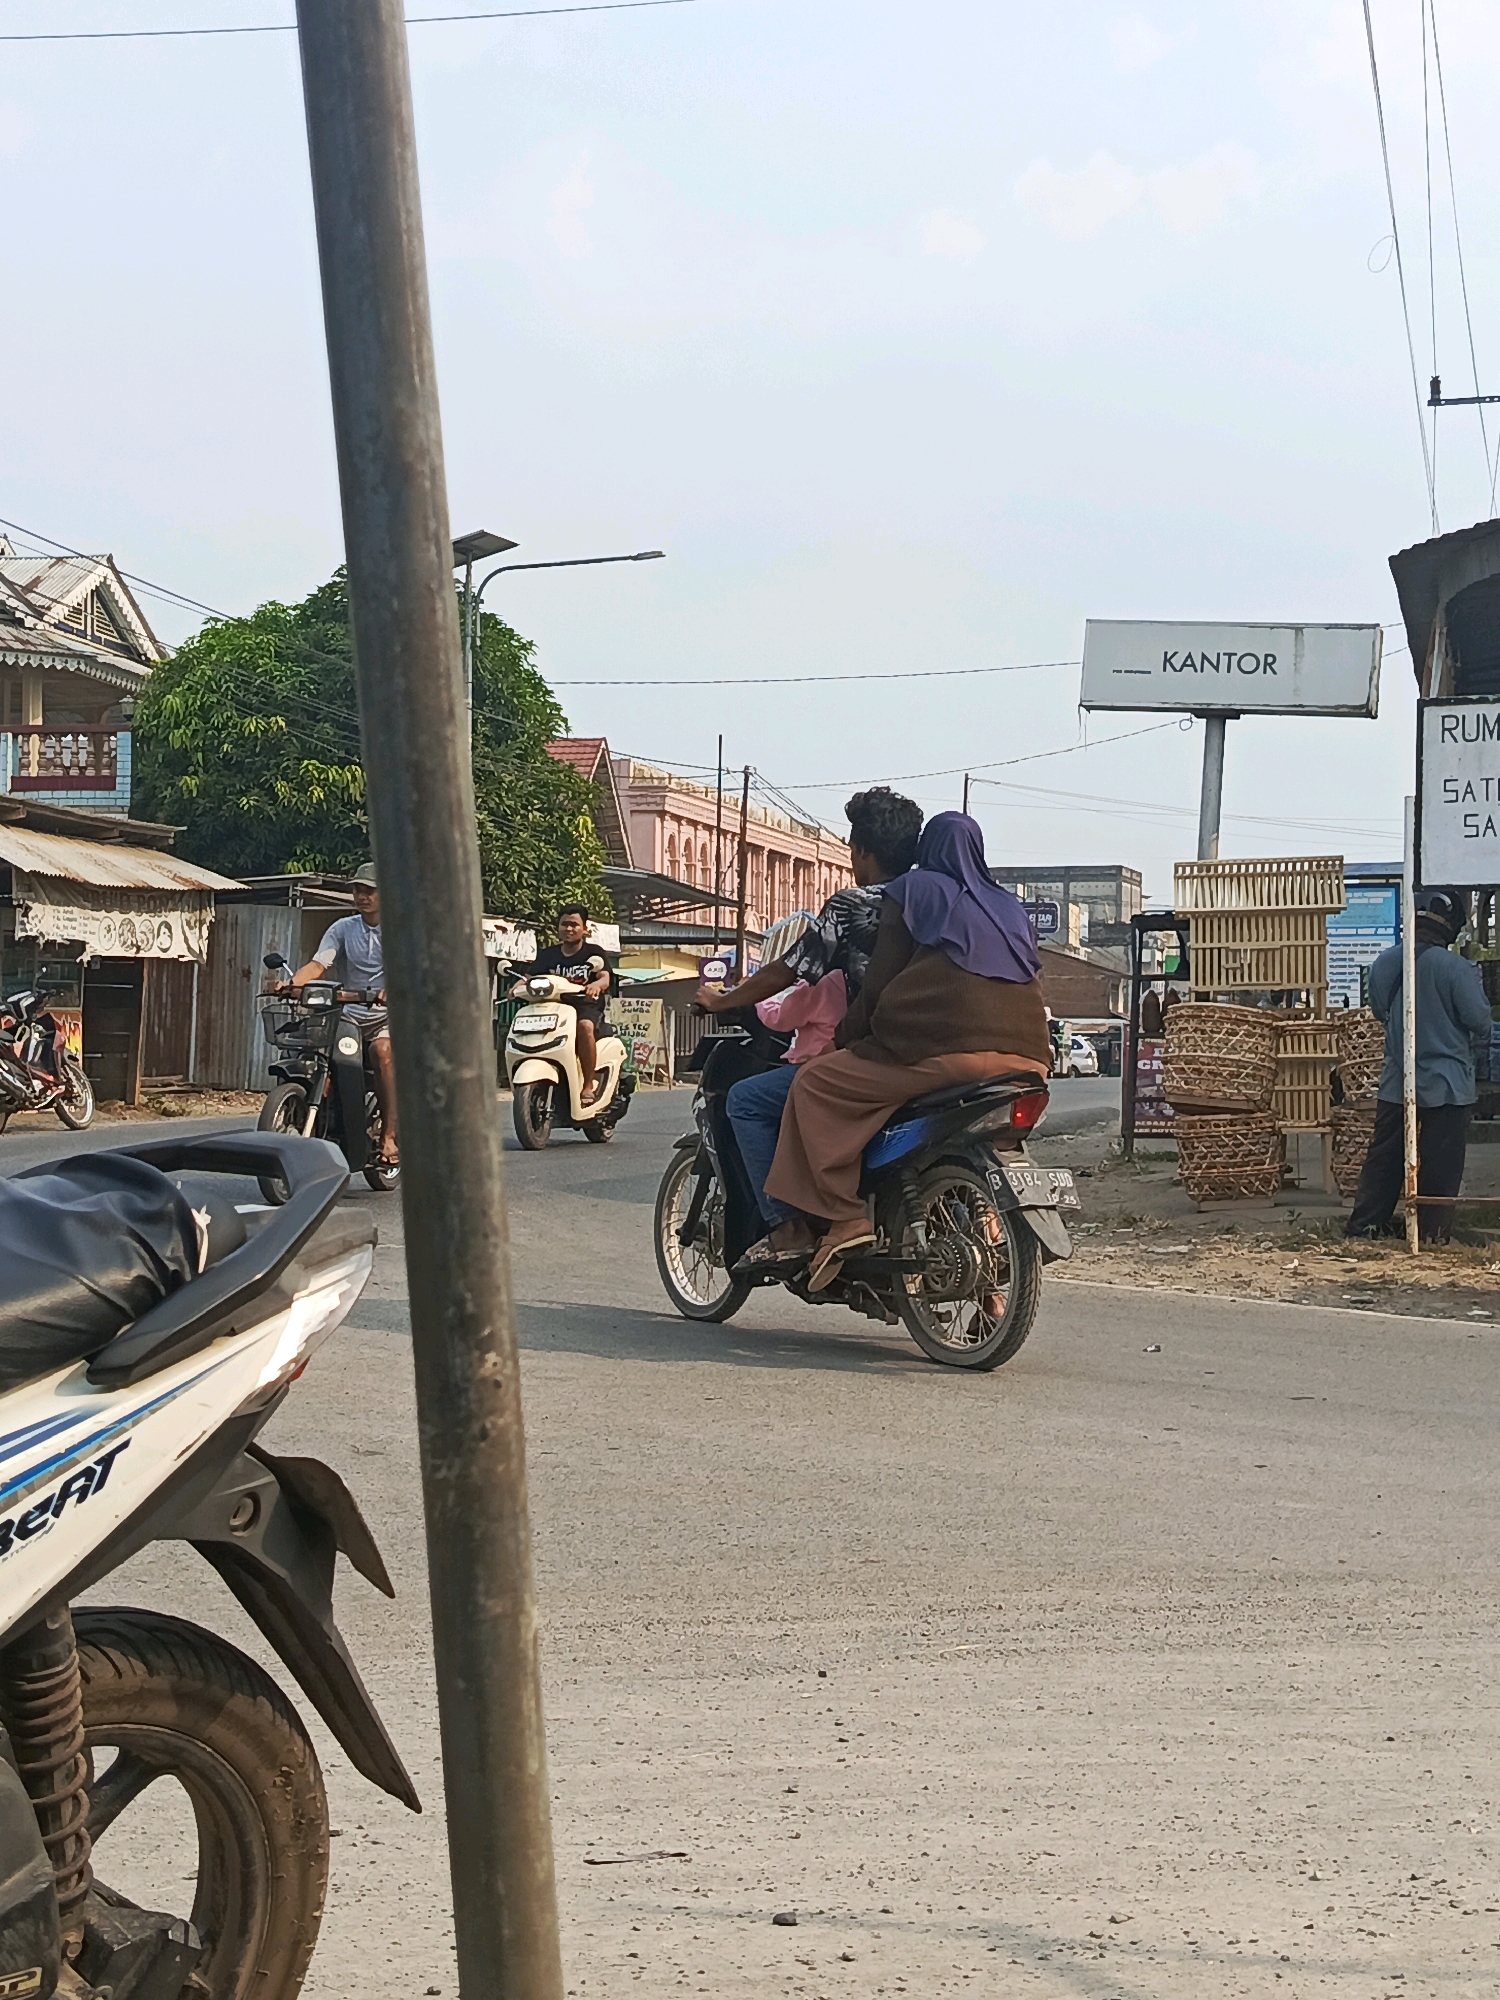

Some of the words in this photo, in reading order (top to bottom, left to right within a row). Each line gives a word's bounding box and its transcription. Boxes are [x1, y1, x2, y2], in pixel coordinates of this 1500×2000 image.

[1162, 650, 1278, 676] KANTOR
[1443, 777, 1500, 803] SAT
[990, 1173, 1002, 1191] B
[1008, 1171, 1042, 1187] 3184
